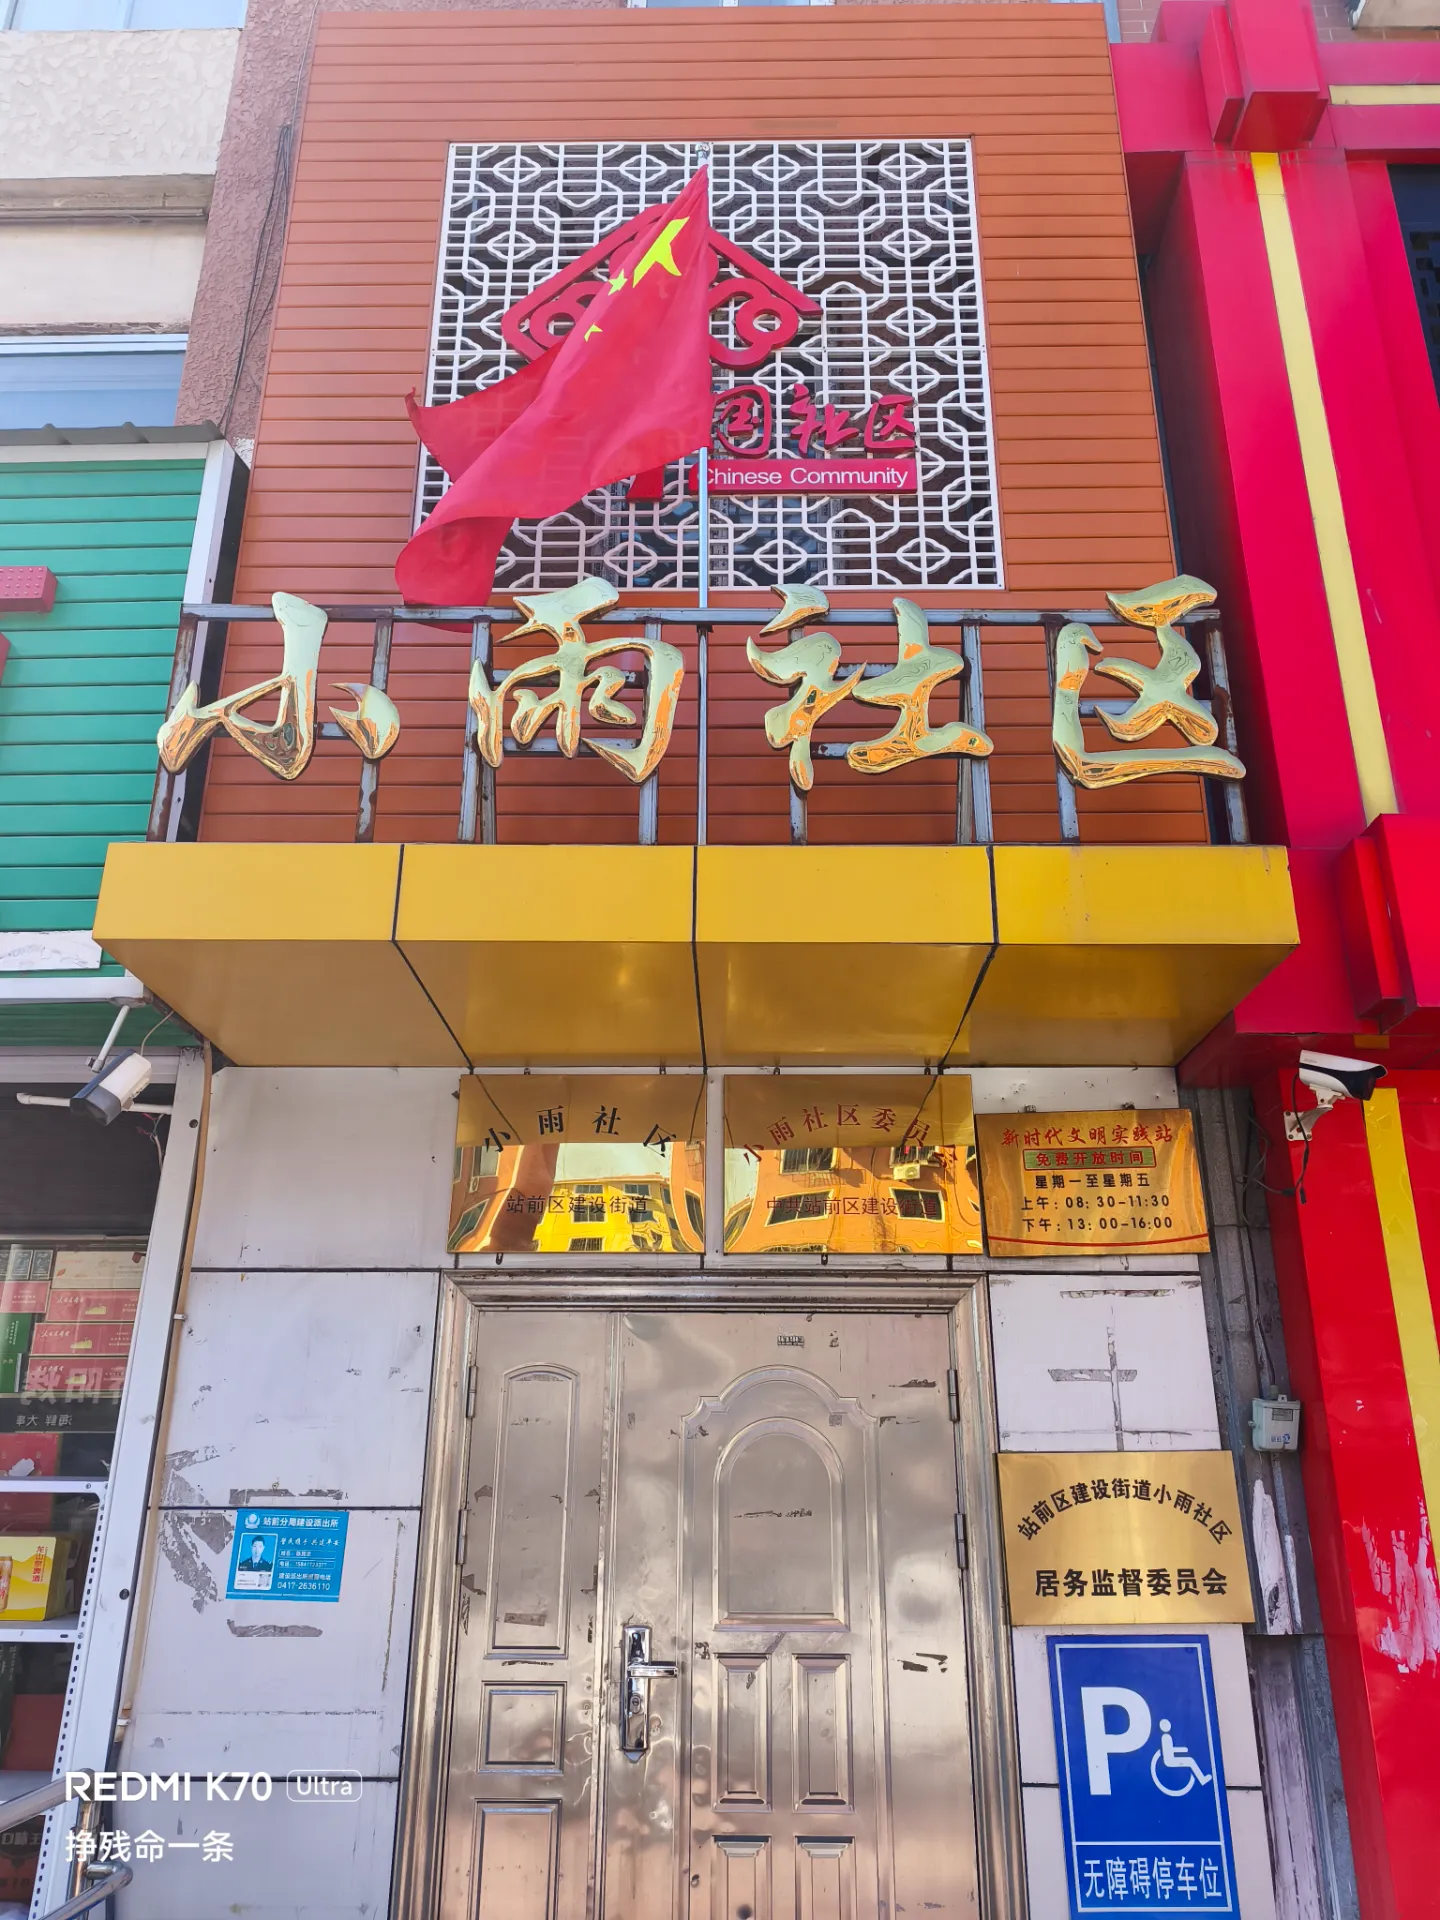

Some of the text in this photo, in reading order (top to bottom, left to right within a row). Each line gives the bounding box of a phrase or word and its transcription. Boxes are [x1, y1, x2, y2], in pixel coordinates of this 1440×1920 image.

[790, 467, 909, 488] Community
[156, 575, 1247, 790] 小雨社区
[484, 1104, 677, 1158] 小雨社区
[743, 1103, 959, 1169] 小雨社区委员会
[1001, 1123, 1173, 1148] 新时代文明实践站
[1036, 1150, 1143, 1167] 免费开放时间
[1035, 1173, 1150, 1189] 星期一至星期五
[506, 1194, 649, 1215] 站前区建设街道
[766, 1196, 937, 1216] 中共站前区建设街道
[263, 1516, 339, 1528] 站前分局建设派出所
[1017, 1477, 1233, 1545] 站前区建设街道小雨社区
[1035, 1567, 1228, 1598] 居务监督委员会
[1081, 1686, 1152, 1796] P
[1083, 1855, 1222, 1901] 无障碍停车位
